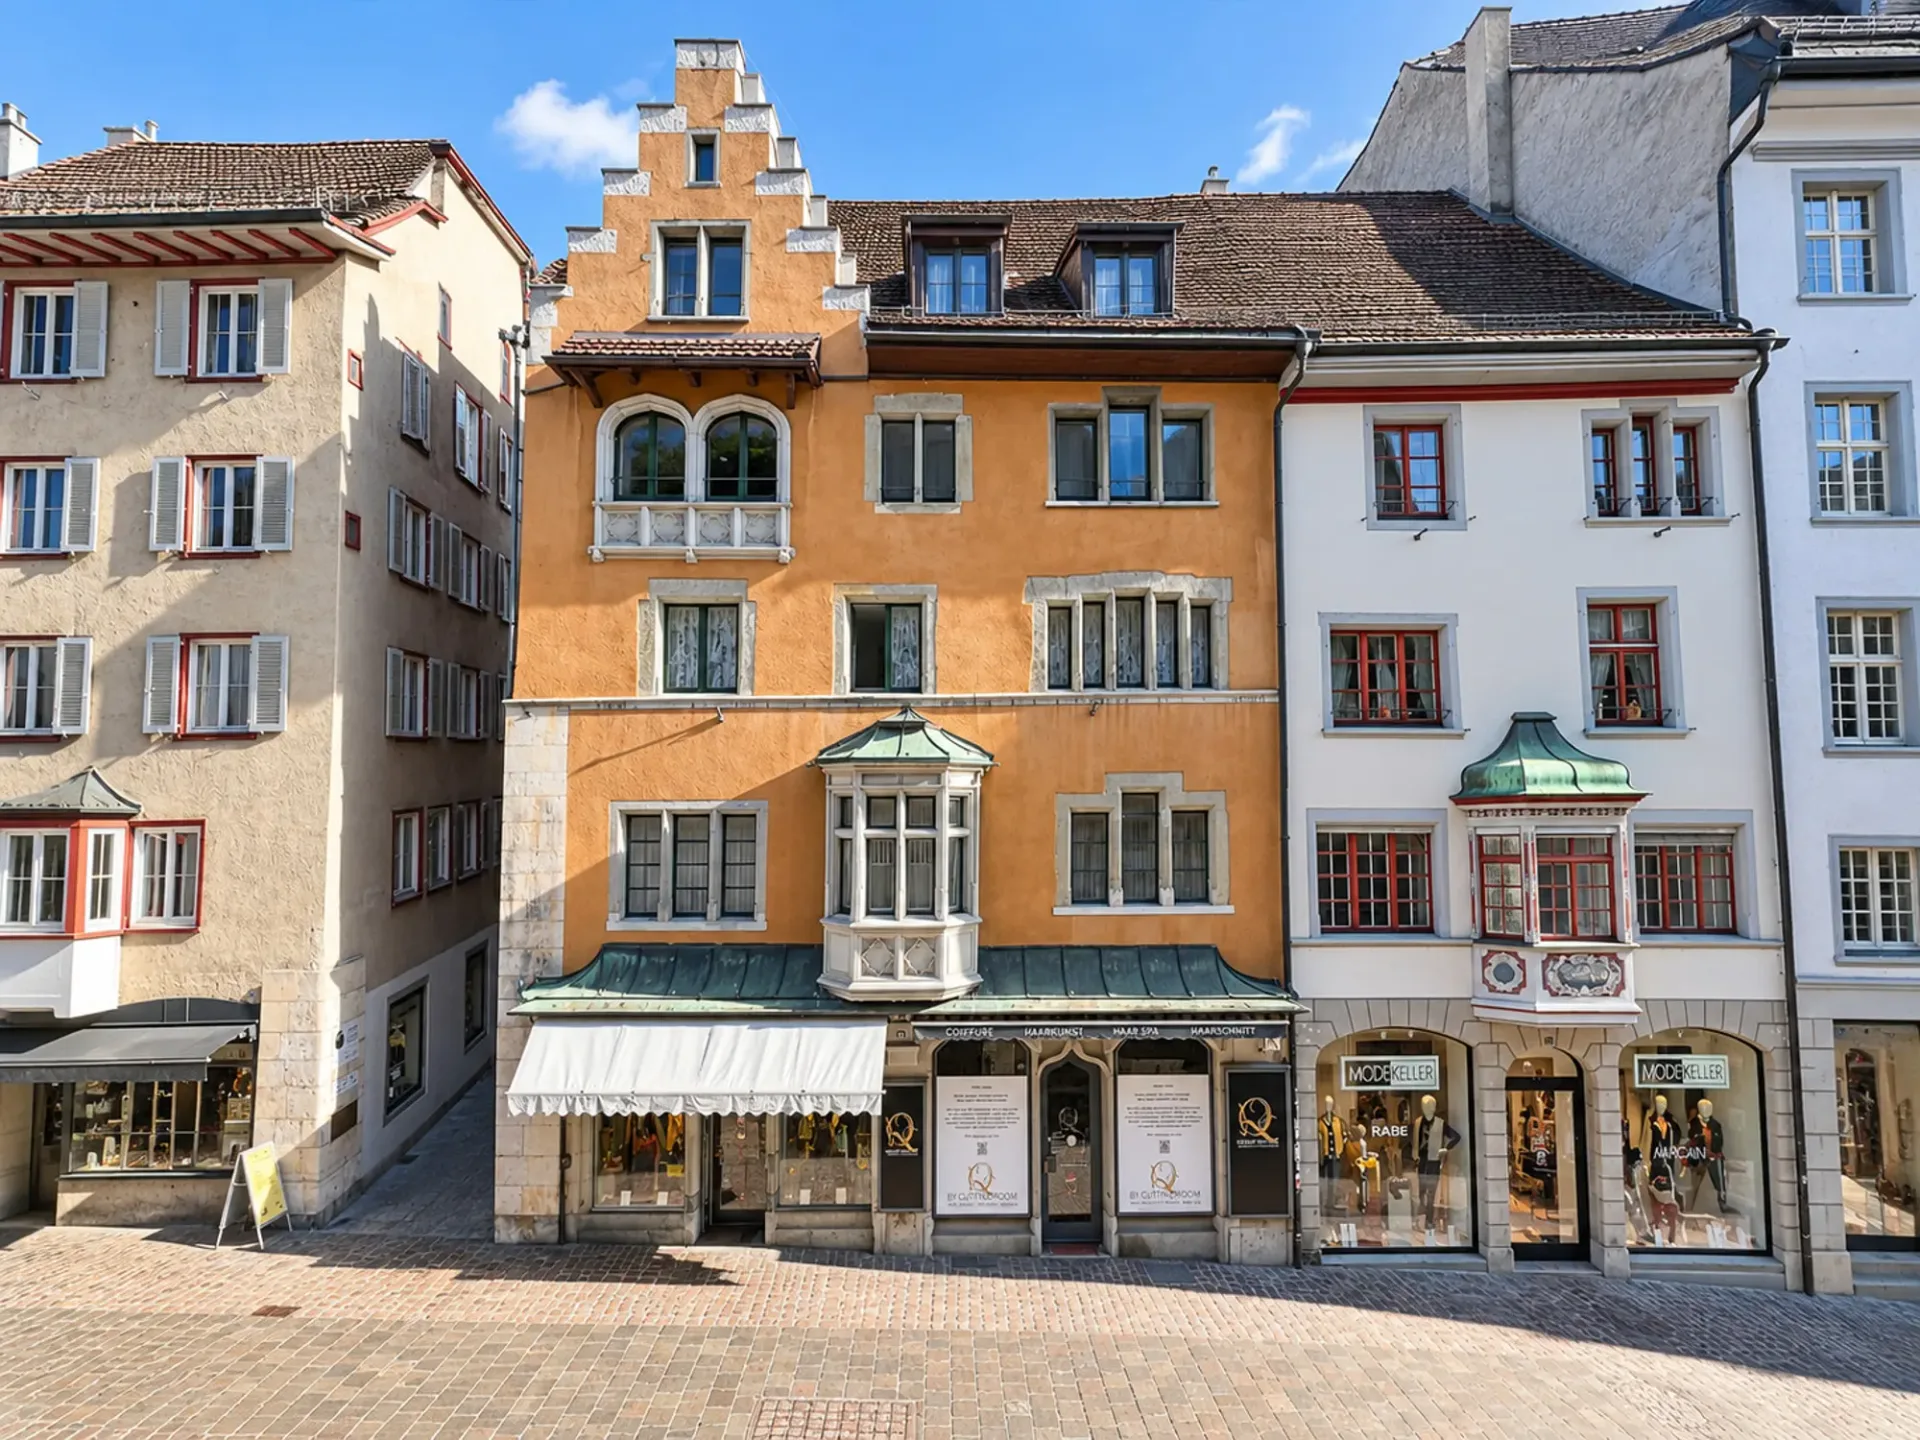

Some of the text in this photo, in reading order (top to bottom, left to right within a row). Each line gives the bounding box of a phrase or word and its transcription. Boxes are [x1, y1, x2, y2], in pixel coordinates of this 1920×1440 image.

[945, 1027, 994, 1037] COIFFURE
[1112, 1027, 1138, 1036] HAAR
[1371, 1125, 1409, 1137] RABE
